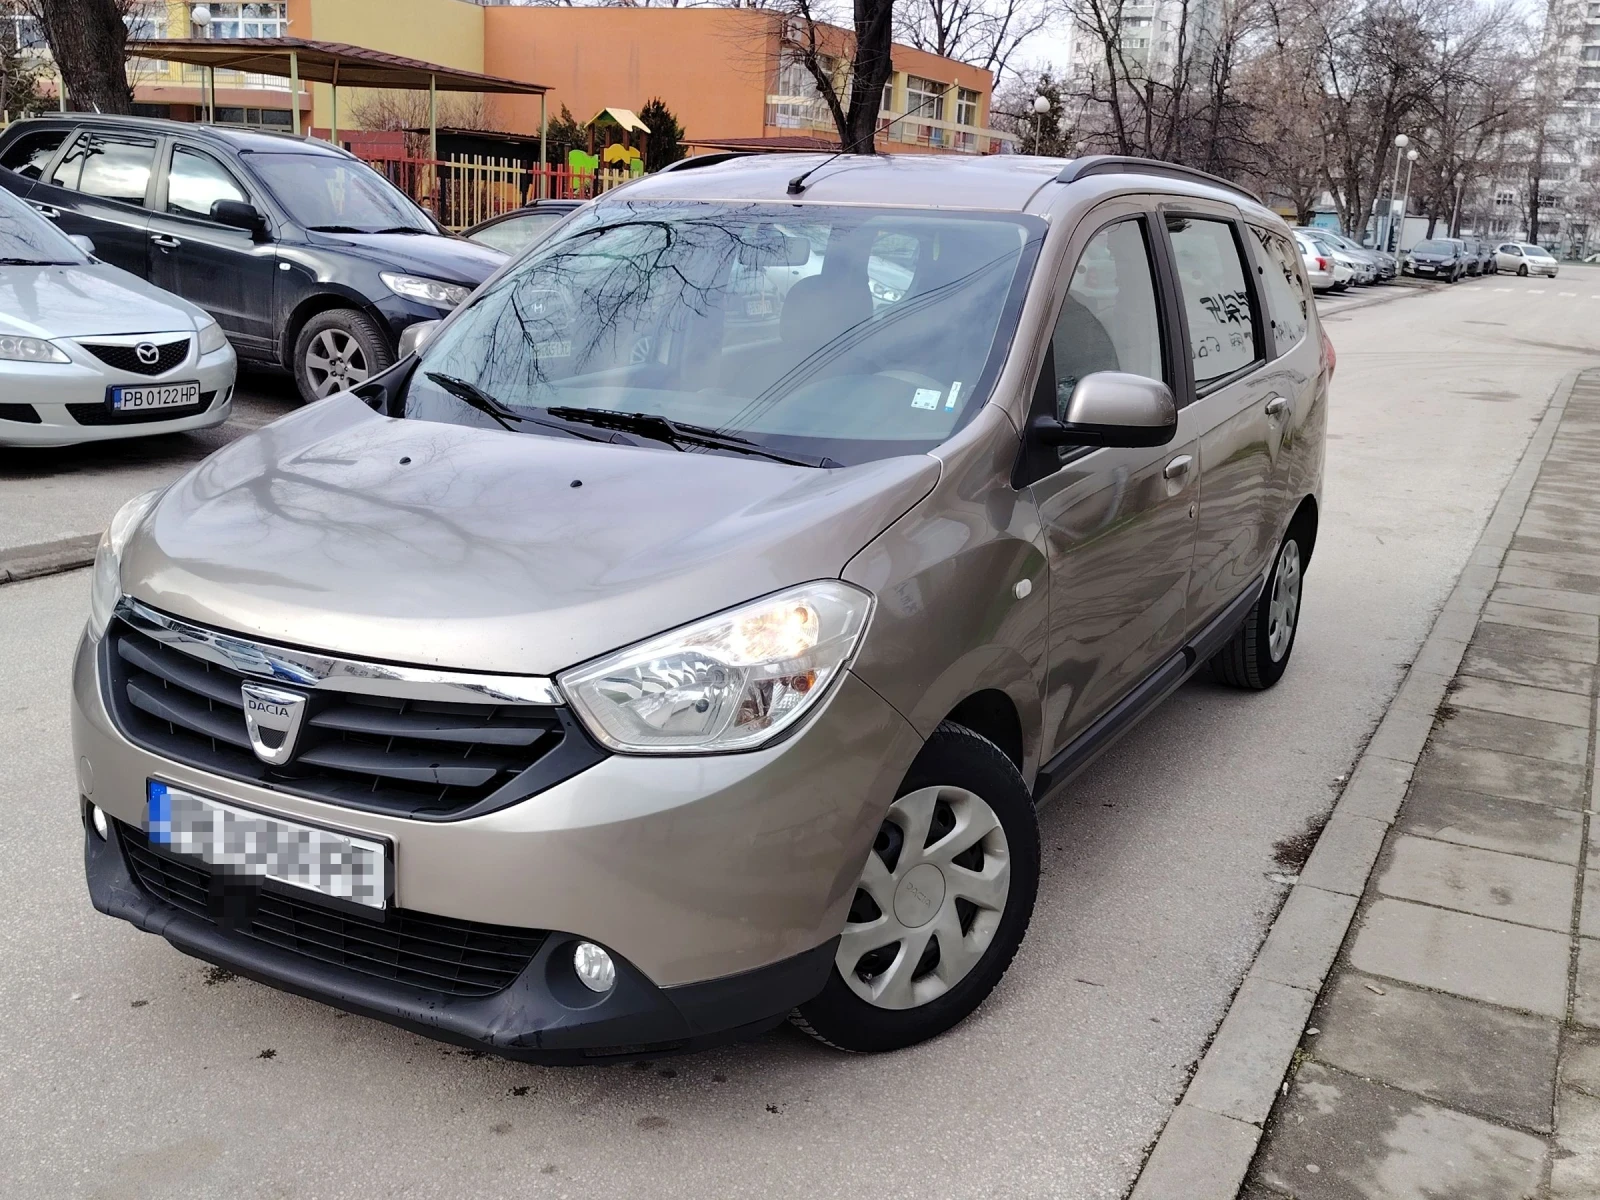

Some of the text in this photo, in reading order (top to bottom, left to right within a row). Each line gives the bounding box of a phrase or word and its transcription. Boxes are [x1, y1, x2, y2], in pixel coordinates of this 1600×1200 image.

[124, 386, 197, 408] PB 0122 HP
[248, 700, 290, 718] DACIA
[906, 882, 932, 909] DACIA
